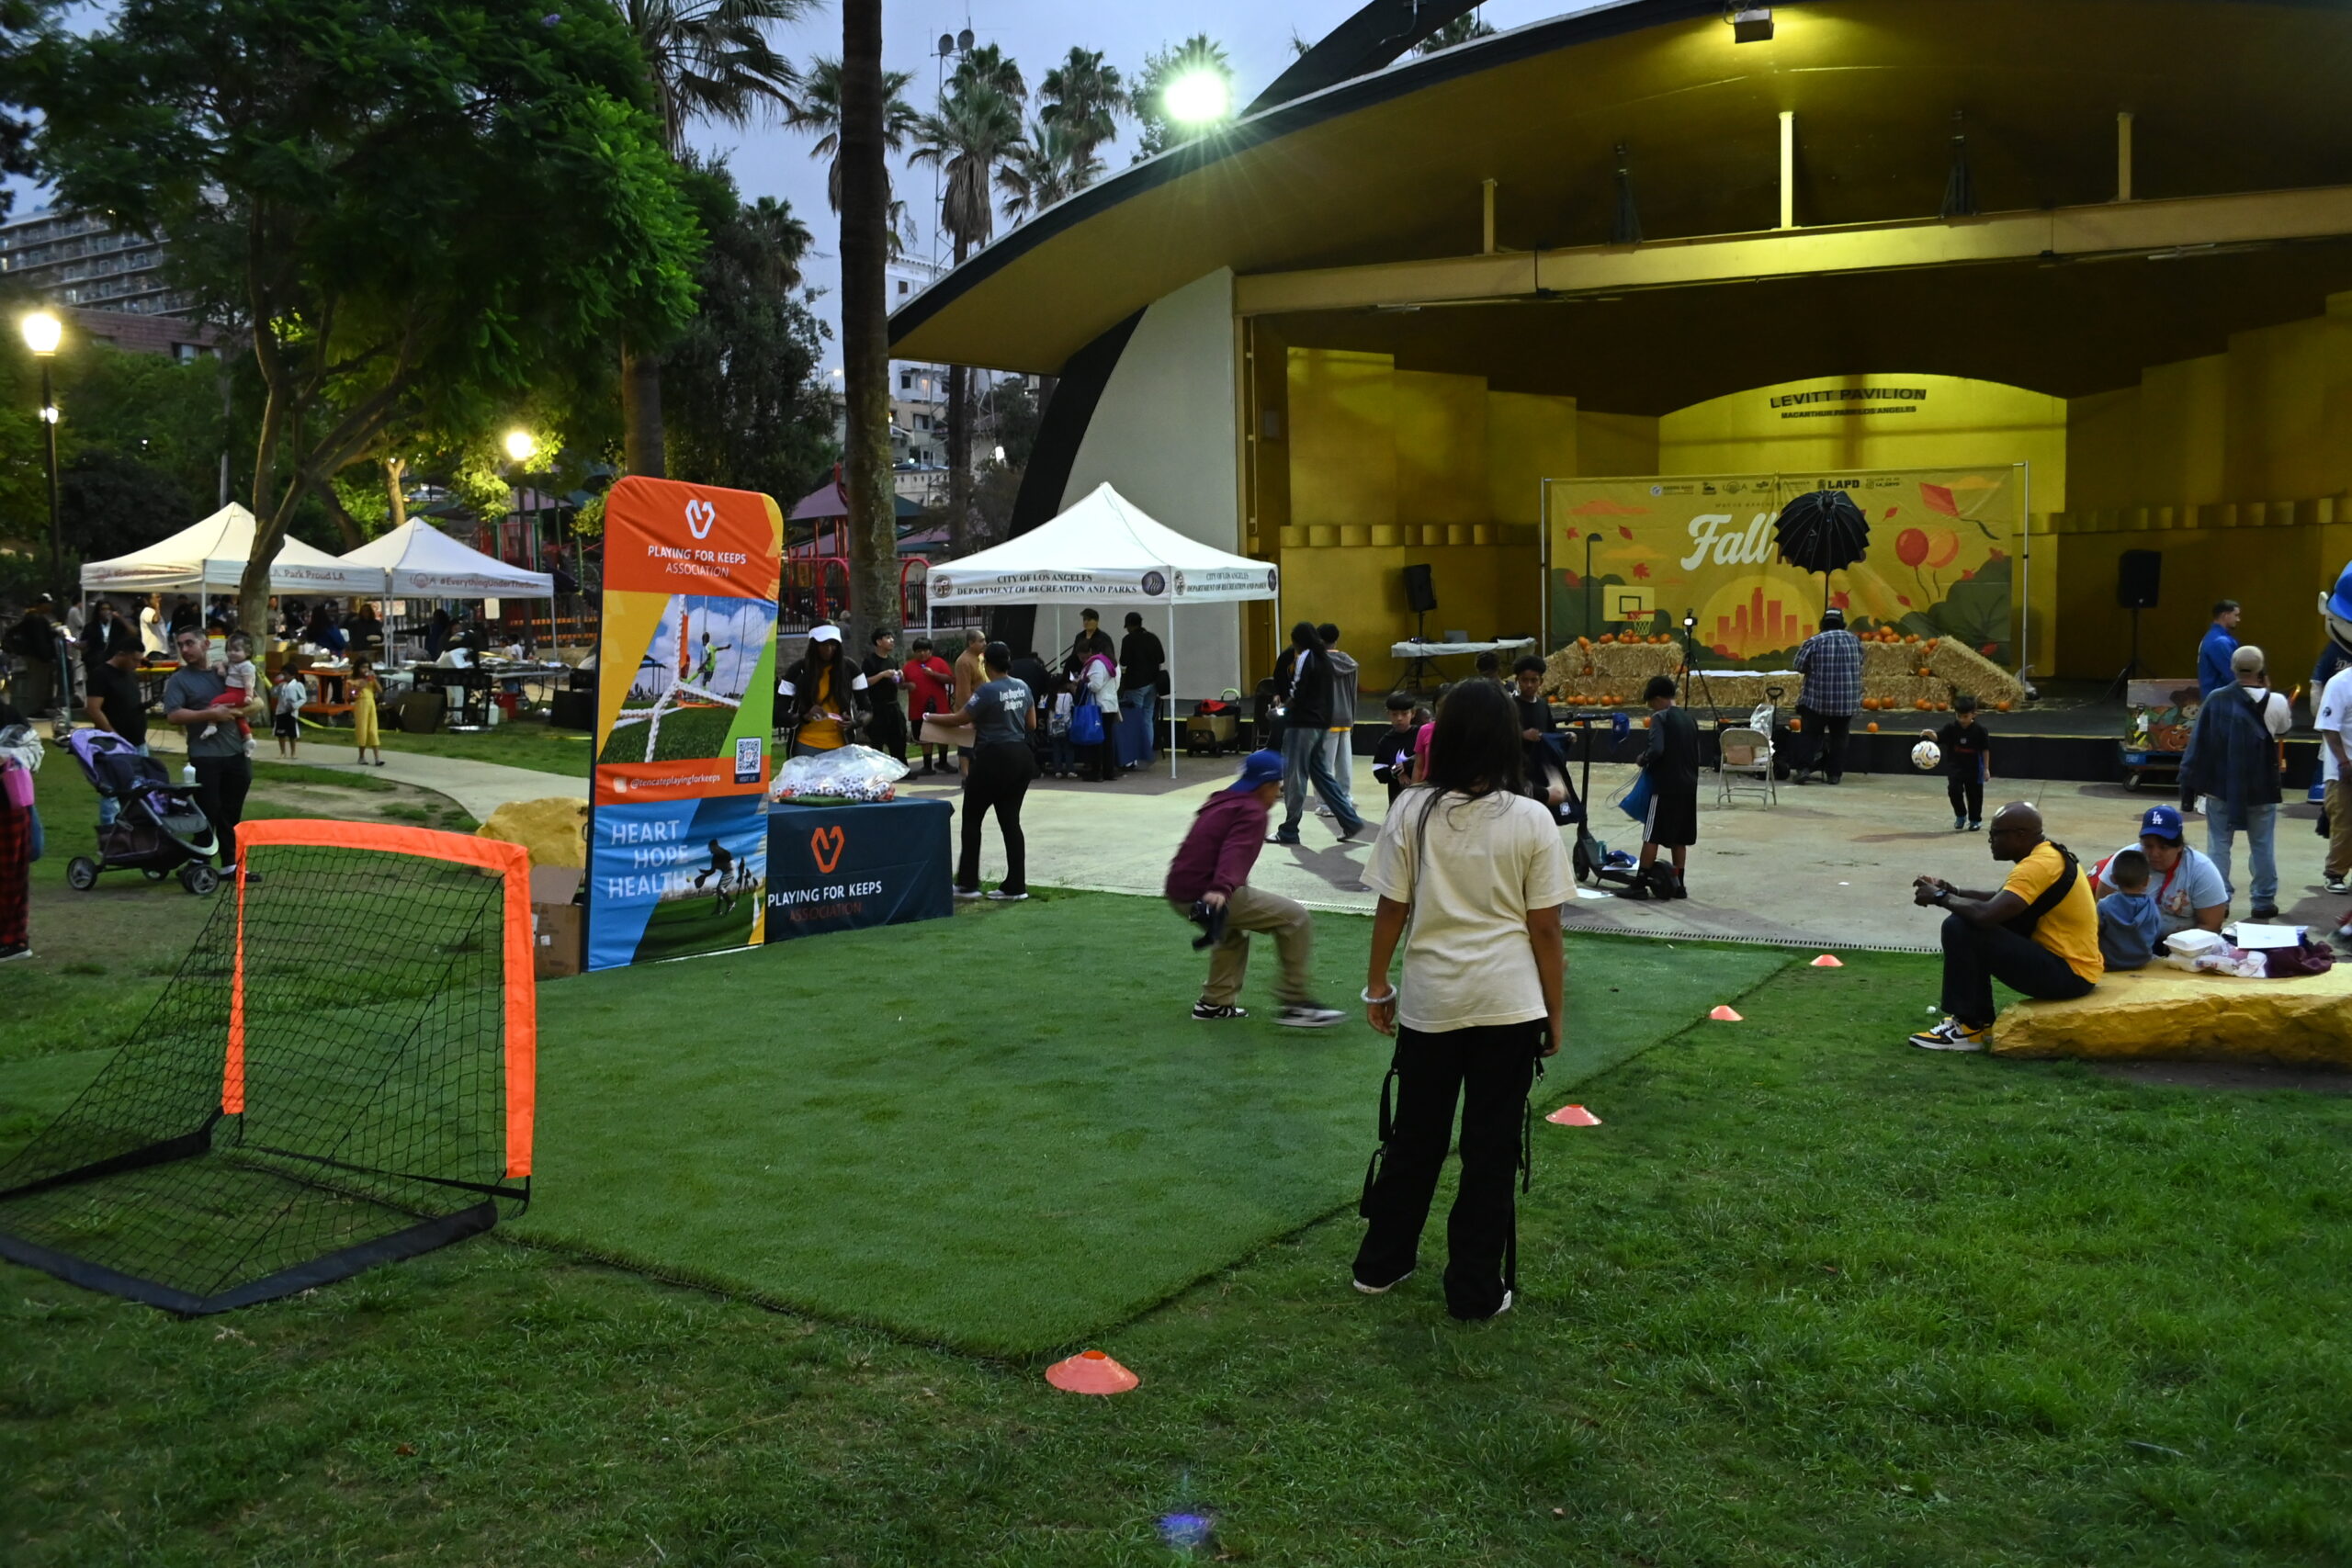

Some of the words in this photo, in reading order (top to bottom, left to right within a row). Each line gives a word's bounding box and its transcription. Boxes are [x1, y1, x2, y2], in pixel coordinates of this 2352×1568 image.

[1770, 390, 1834, 409] LEVITT
[1839, 388, 1928, 400] PAVILION
[1781, 410, 1833, 419] MACARTHUR
[1858, 407, 1875, 415] LOS
[1827, 479, 1860, 490] LAPD
[1680, 511, 1778, 571] Fall
[648, 545, 692, 559] PLAYING
[694, 549, 715, 562] FOR
[717, 552, 747, 565] KEEPS
[284, 569, 304, 578] Park
[305, 570, 331, 581] Proud
[332, 571, 345, 581] LA
[665, 562, 729, 578] ASSOCIATION
[997, 574, 1018, 583] CITY
[1020, 574, 1031, 583] OF
[1033, 574, 1051, 582] LOS
[1051, 573, 1092, 582] ANGELES
[1231, 572, 1250, 581] ANGELES
[956, 585, 1013, 595] DEPARTMENT
[1014, 585, 1027, 594] OF
[1028, 585, 1086, 594] RECREATION
[1087, 585, 1106, 594] AND
[1107, 584, 1137, 594] PARKS
[1186, 583, 1216, 592] DEPARTMENT
[630, 773, 721, 790] @tencateplayingforkeeps
[2152, 810, 2163, 825] LA
[611, 819, 680, 845] HEART
[633, 844, 688, 870] HOPE
[608, 870, 687, 899] HEALTH
[767, 888, 820, 908] PLAYING
[823, 885, 845, 900] FOR
[849, 880, 882, 897] KEEPS
[789, 901, 863, 922] ASSOCIATION
